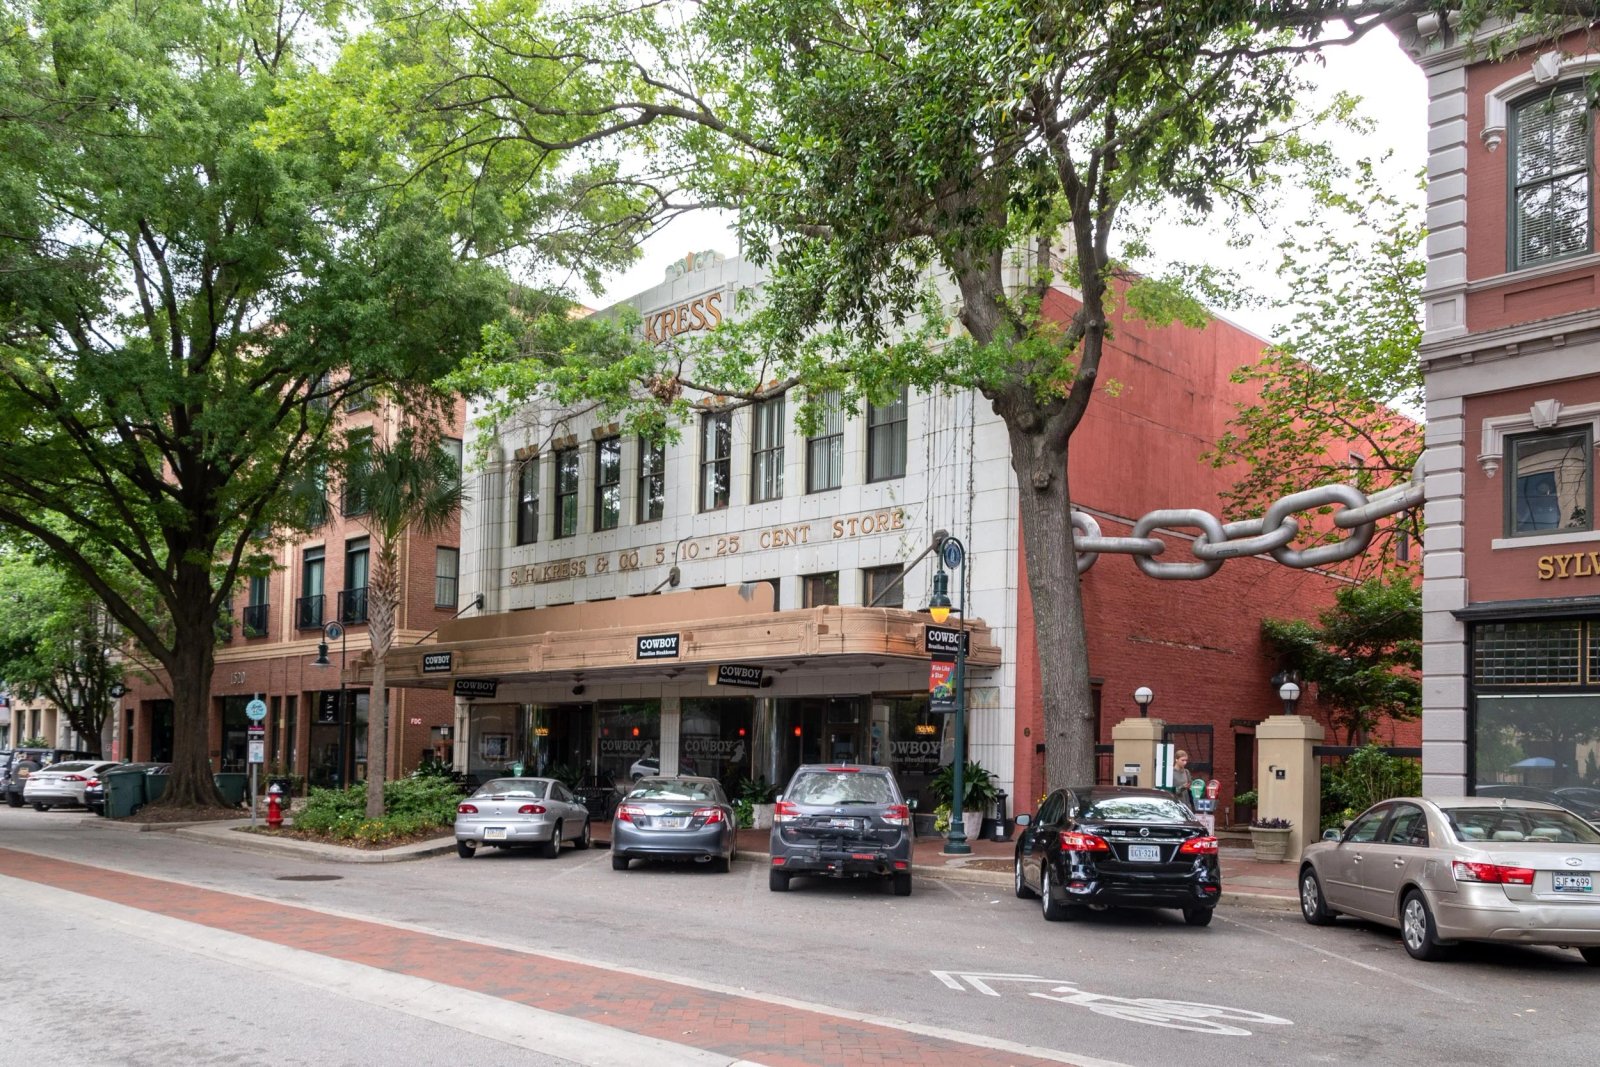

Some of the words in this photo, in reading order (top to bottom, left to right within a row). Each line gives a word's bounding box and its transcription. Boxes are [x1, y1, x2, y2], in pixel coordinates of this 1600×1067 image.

[644, 292, 722, 347] KRESS
[542, 559, 586, 579] KRESS
[596, 555, 608, 572] &
[760, 524, 810, 549] CENT
[832, 510, 904, 539] STORE
[640, 637, 677, 649] COWBOY
[425, 655, 450, 665] COWBOY
[720, 665, 760, 679] COWBOY
[456, 681, 495, 690] COWBOY
[600, 740, 642, 751] COWBOY
[685, 740, 733, 752] COWBOY
[1576, 878, 1590, 887] 699
